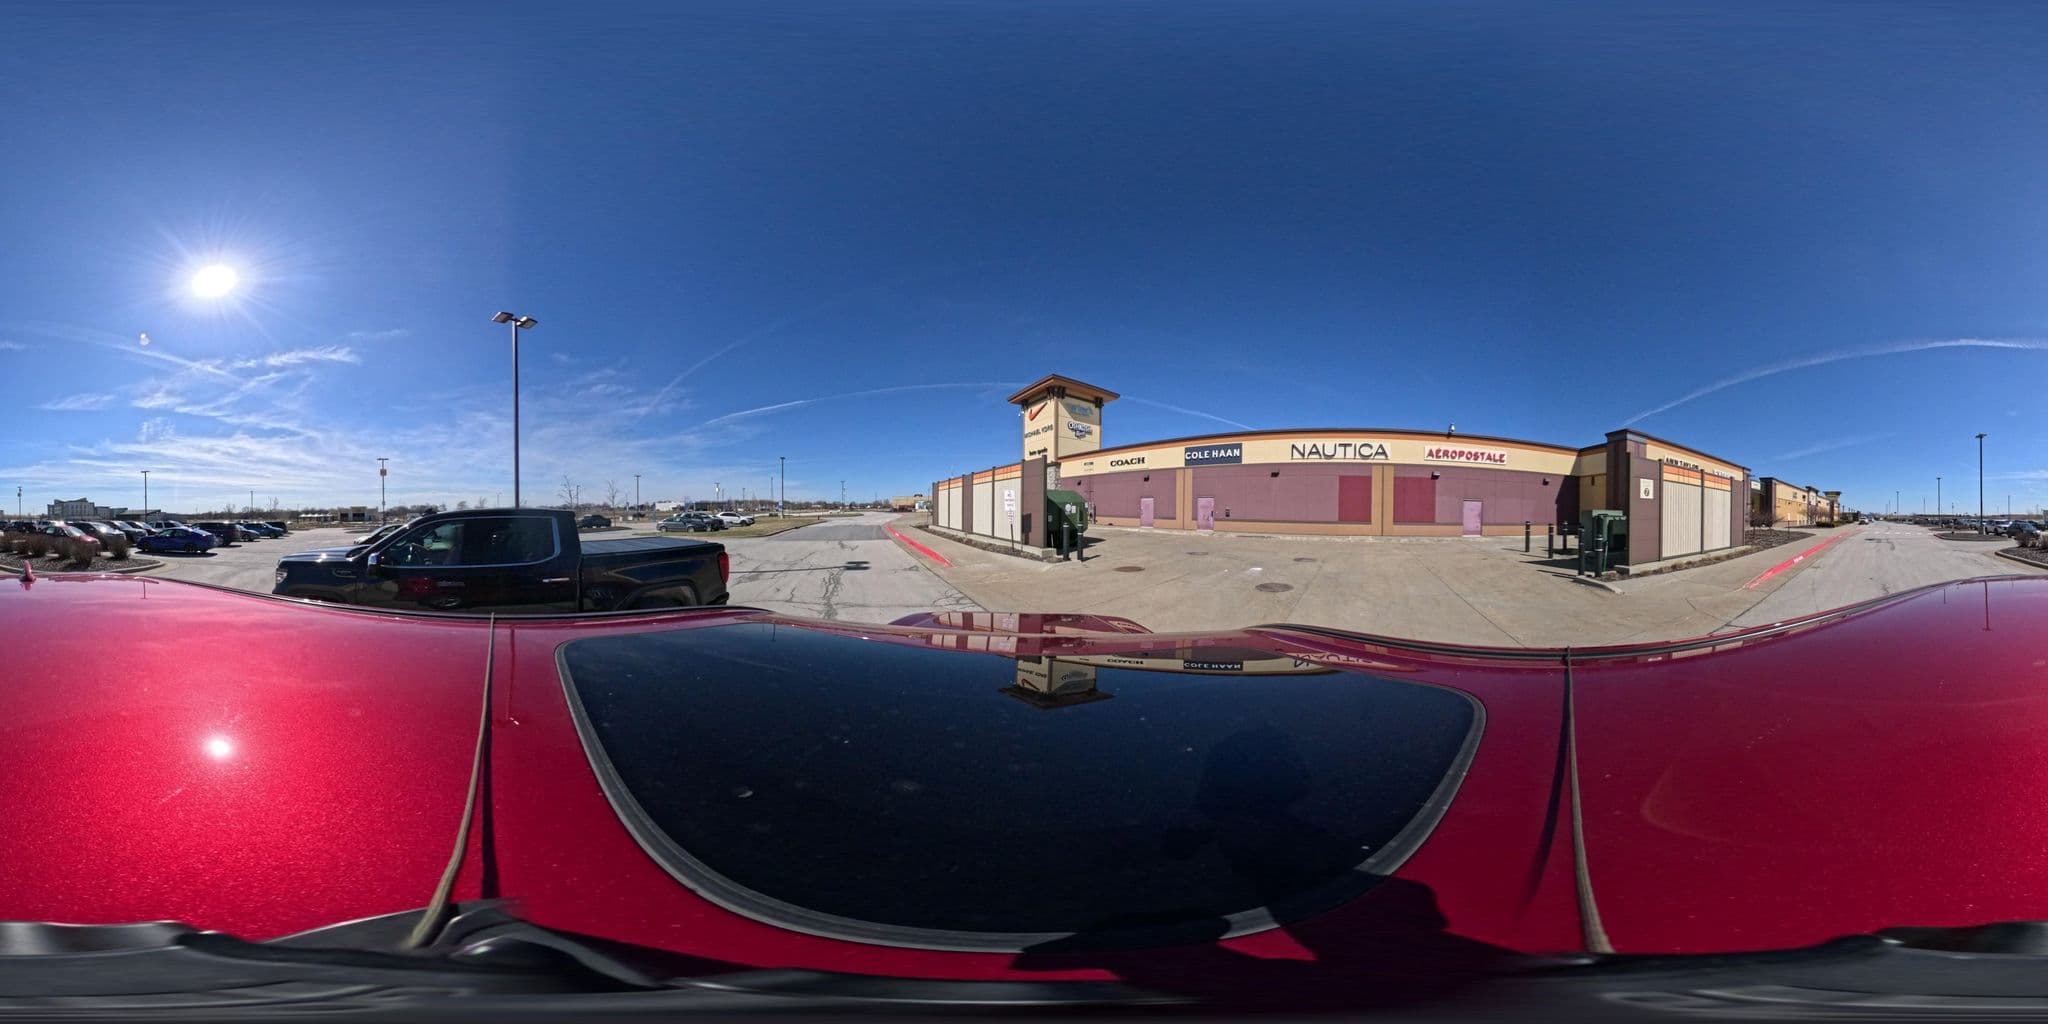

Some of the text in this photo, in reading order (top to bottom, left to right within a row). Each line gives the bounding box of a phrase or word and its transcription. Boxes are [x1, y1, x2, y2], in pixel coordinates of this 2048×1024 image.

[1185, 448, 1240, 460] COLE HAAN
[1291, 443, 1389, 459] NAUTICA
[1426, 447, 1506, 463] AÉROPOSTALE
[1110, 456, 1145, 467] COACH
